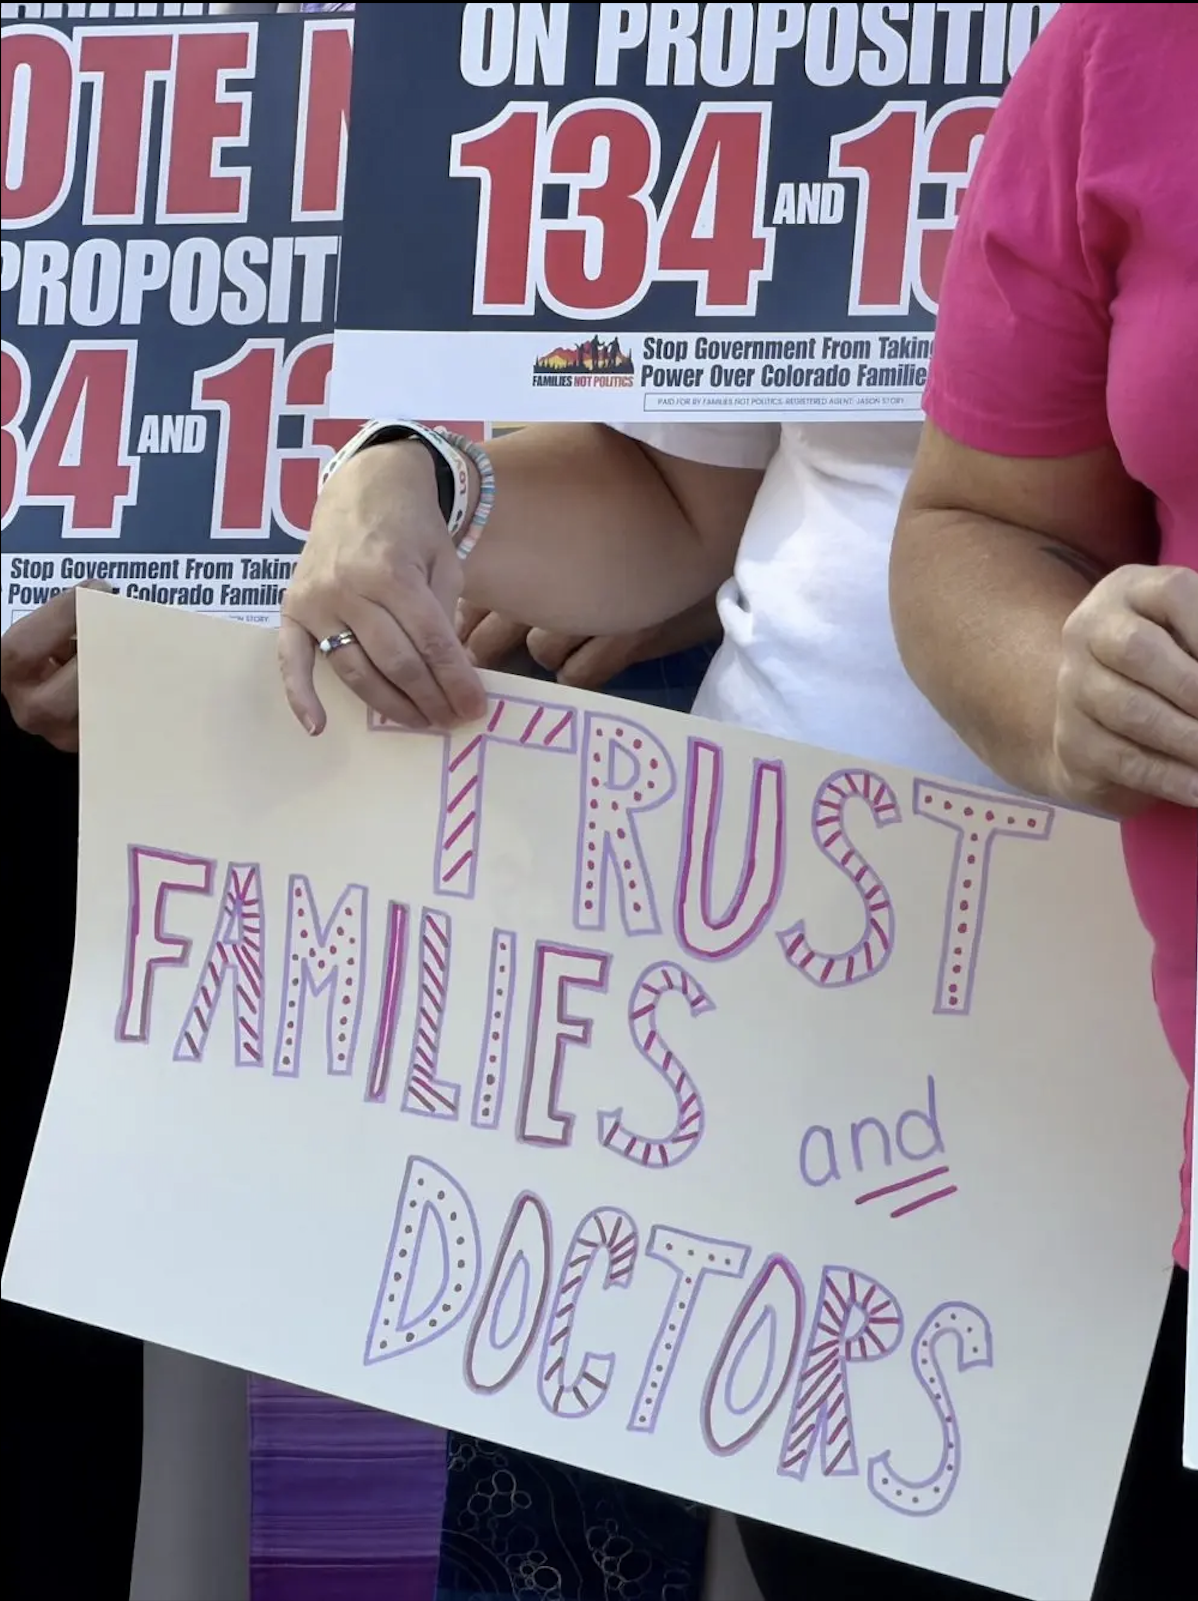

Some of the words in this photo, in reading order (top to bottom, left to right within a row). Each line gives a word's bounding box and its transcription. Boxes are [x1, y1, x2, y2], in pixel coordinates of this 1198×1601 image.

[459, 3, 567, 86] ON
[447, 96, 776, 320] 134
[772, 182, 844, 225] AND
[532, 375, 572, 387] FAMILIES
[573, 375, 592, 387] NOT
[593, 375, 634, 387] POLITICS
[640, 363, 704, 388] Power
[710, 363, 755, 388] Over
[760, 363, 851, 387] Colorado
[642, 336, 687, 362] Stop
[694, 336, 815, 360] Government
[821, 336, 872, 360] From
[878, 335, 935, 360] Takin
[137, 414, 206, 454] AND
[10, 557, 55, 581] Stop
[60, 557, 179, 580] Government
[184, 558, 234, 580] From
[240, 558, 298, 580] Takin
[366, 692, 1055, 1015] TRUST
[115, 843, 716, 1169] FAMILIES
[800, 1075, 945, 1187] and
[363, 1154, 994, 1517] DOCTORS
